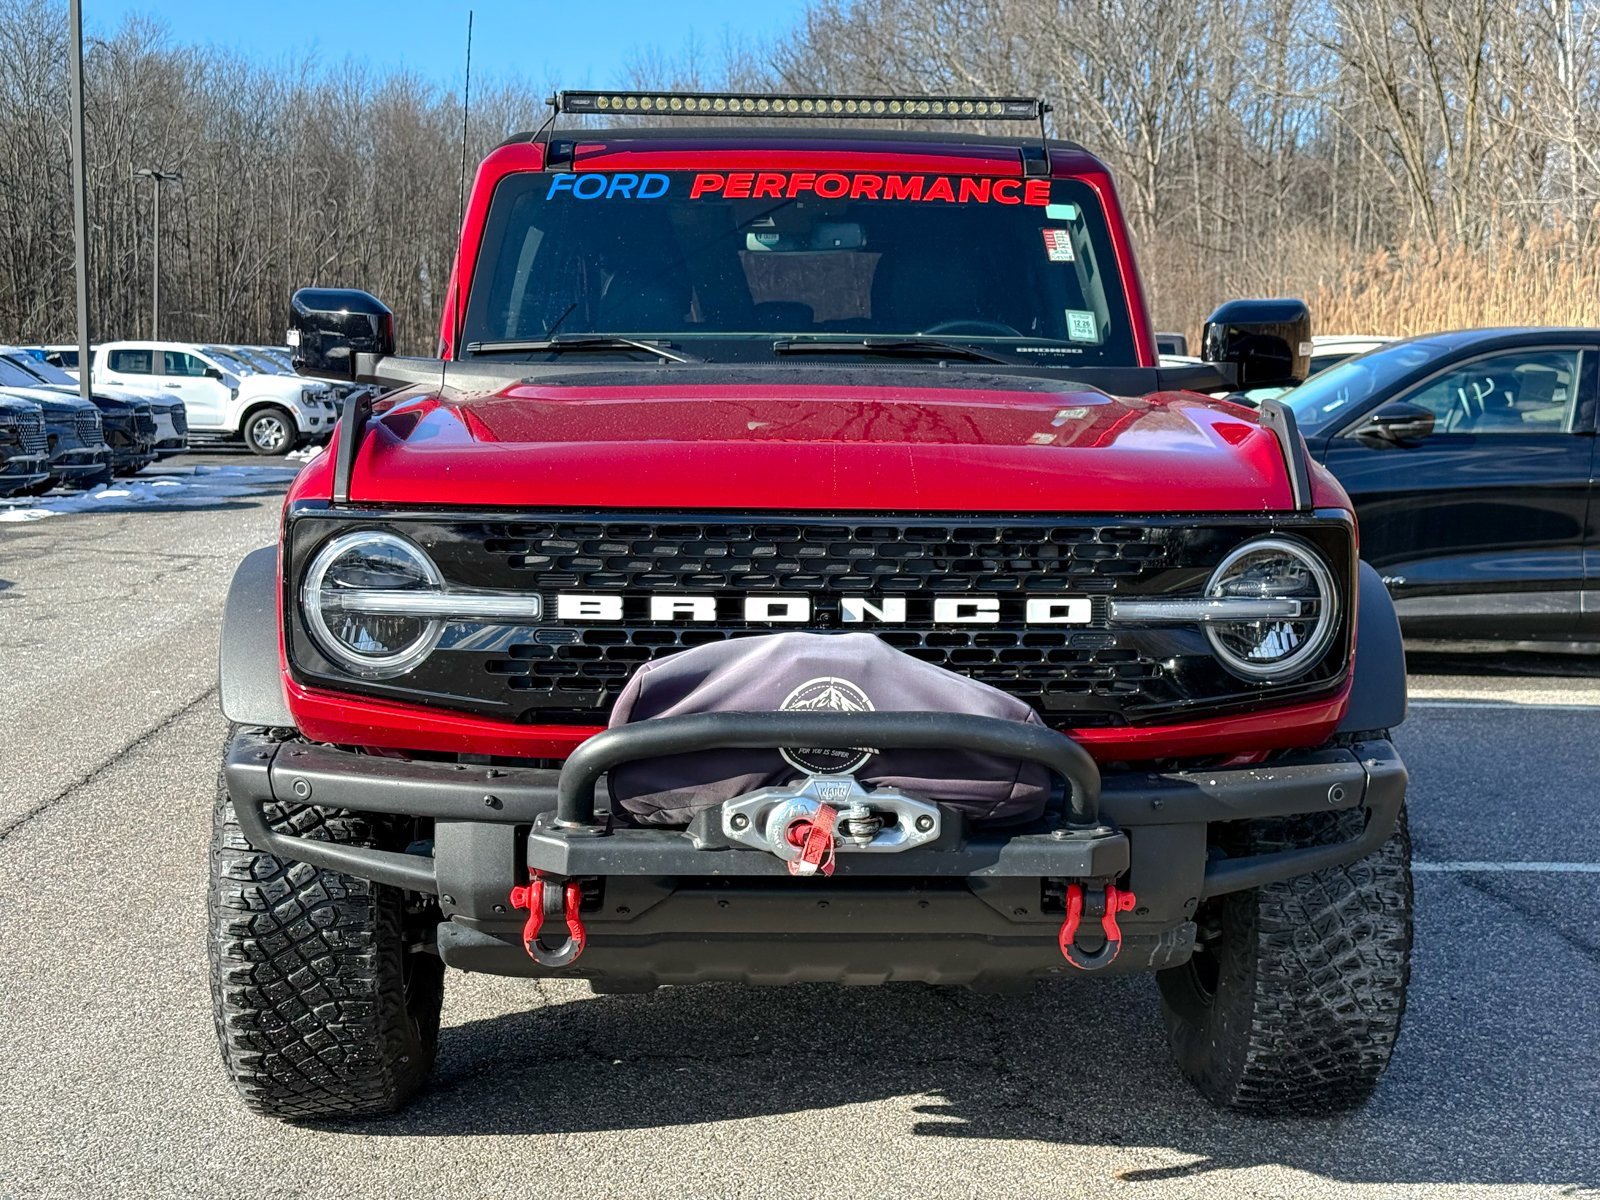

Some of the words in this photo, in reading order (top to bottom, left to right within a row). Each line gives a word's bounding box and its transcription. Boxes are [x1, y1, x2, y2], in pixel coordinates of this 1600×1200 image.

[546, 172, 670, 200] FORD
[690, 172, 1051, 206] PERFORMANCE
[557, 594, 1092, 623] BRONCO
